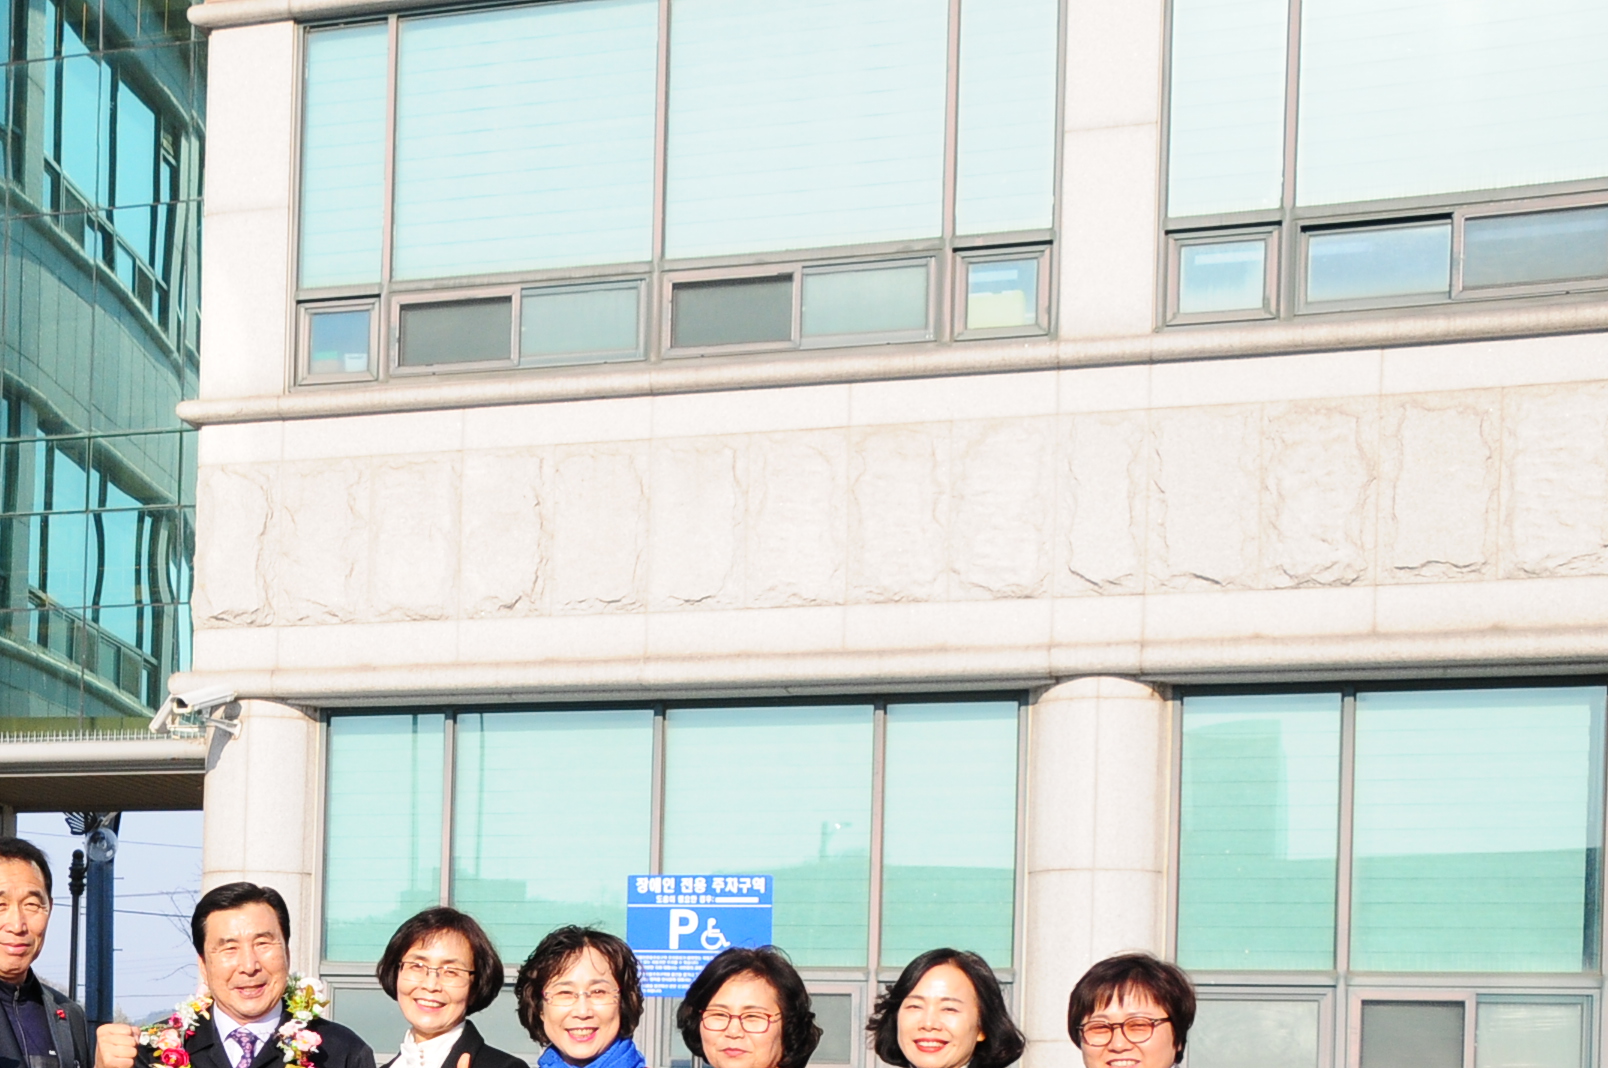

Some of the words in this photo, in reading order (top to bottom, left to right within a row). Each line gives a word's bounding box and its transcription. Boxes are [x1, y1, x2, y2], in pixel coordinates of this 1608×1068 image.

[635, 876, 676, 894] 장애인
[680, 876, 707, 894] 전용
[711, 876, 766, 894] 주차구역
[668, 908, 699, 950] P
